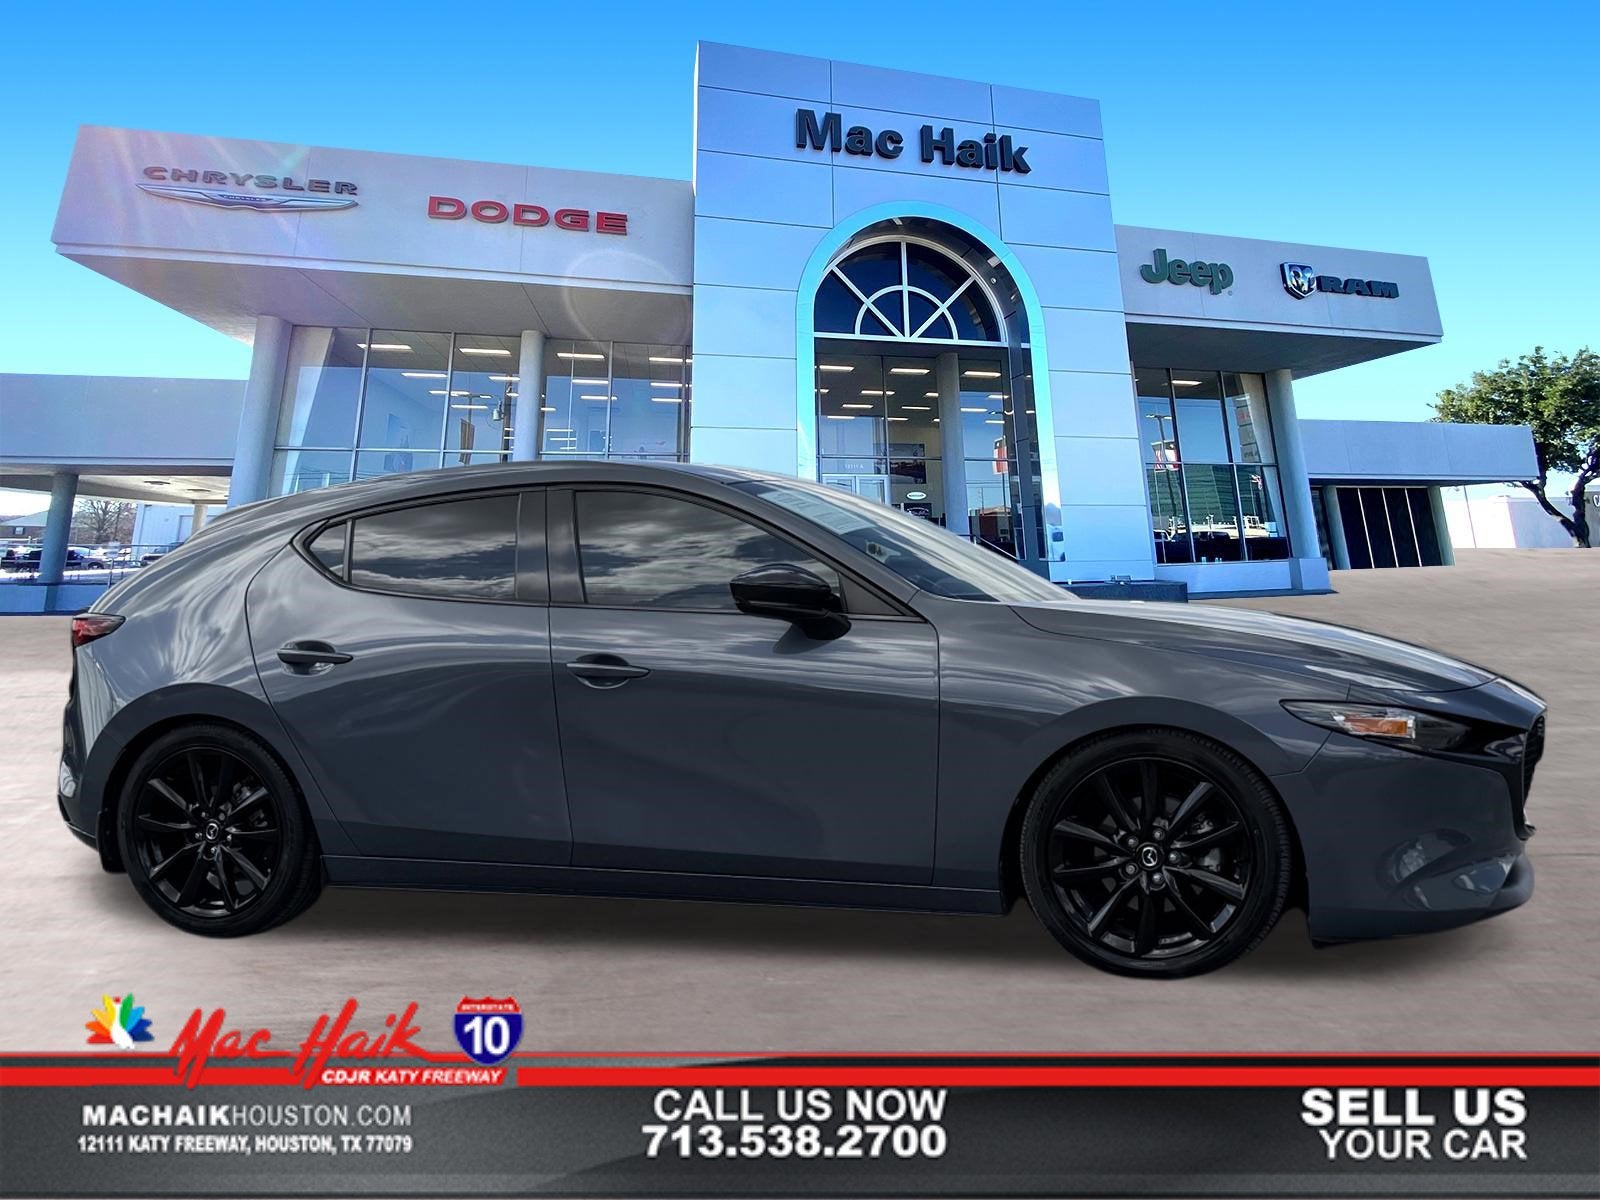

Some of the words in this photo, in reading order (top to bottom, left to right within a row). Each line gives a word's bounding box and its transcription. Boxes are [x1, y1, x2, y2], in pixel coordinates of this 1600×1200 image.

[796, 108, 904, 159] Mac
[920, 125, 1031, 174] Haik
[143, 166, 358, 196] CHRYSLER
[428, 196, 628, 236] DODGE
[1140, 249, 1234, 295] Jeep
[1317, 276, 1399, 298] RAM
